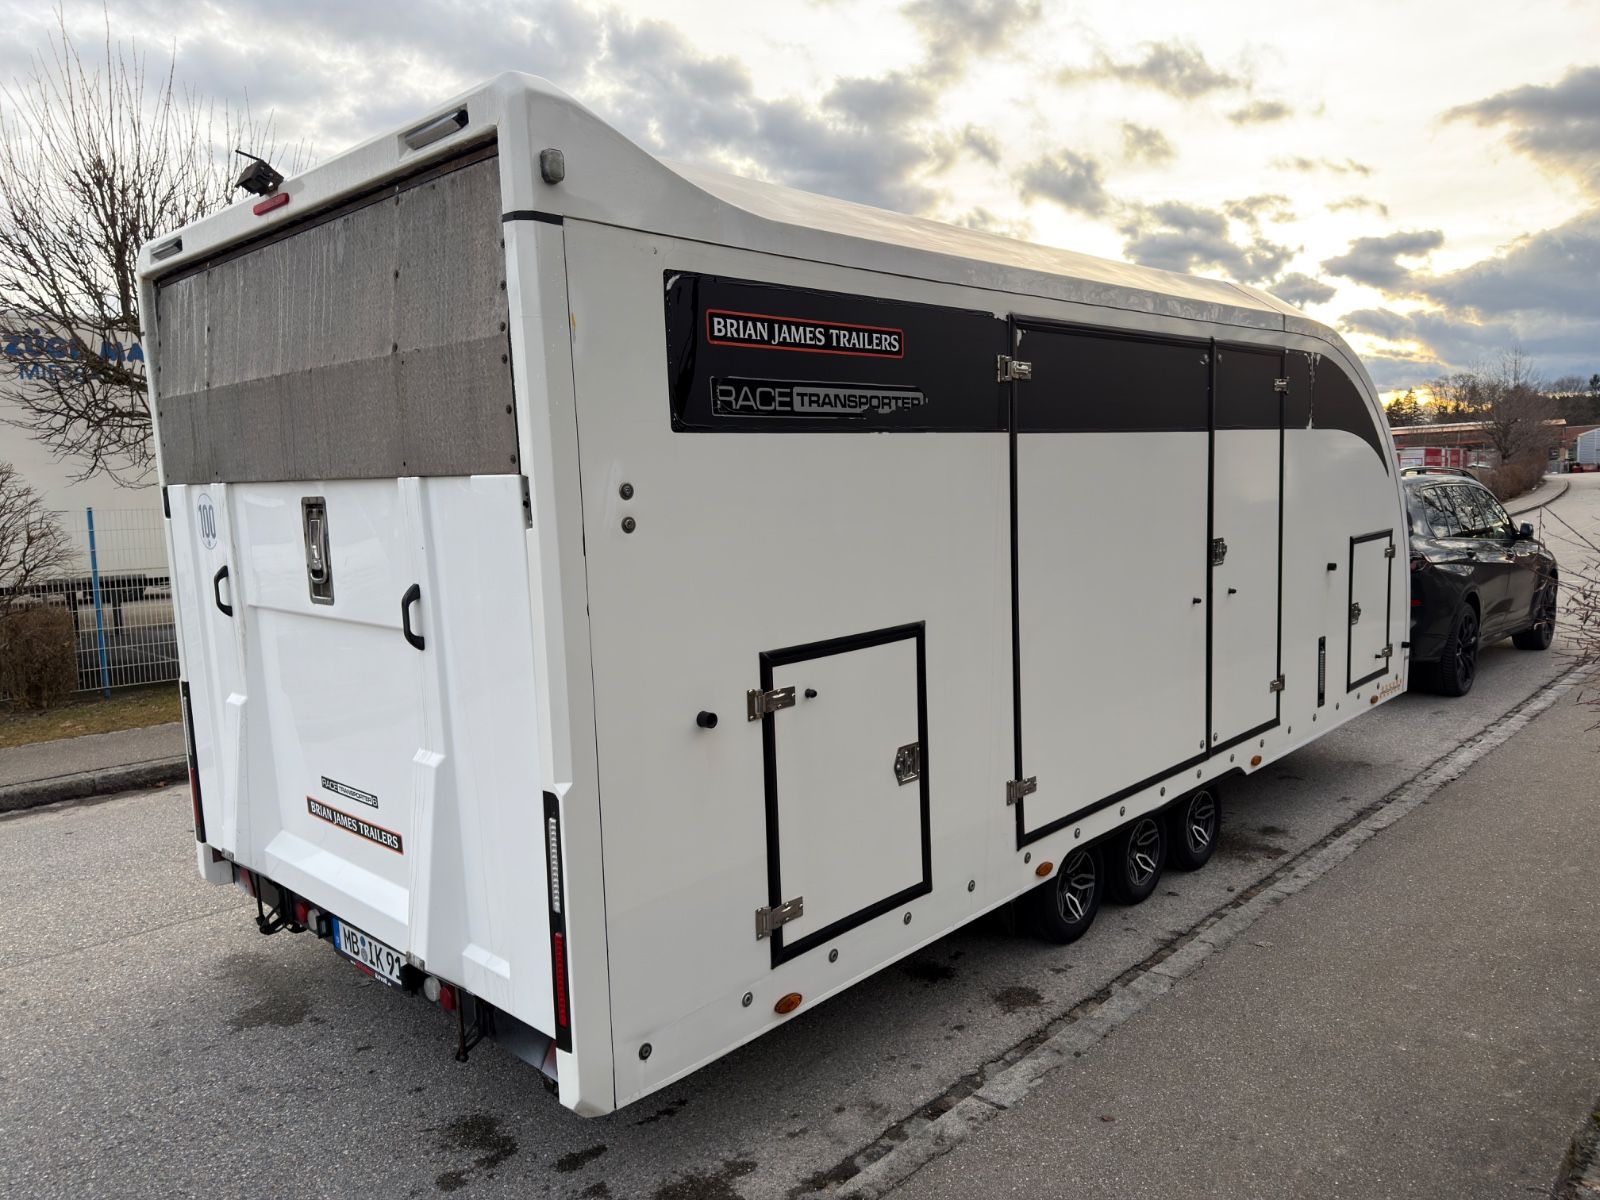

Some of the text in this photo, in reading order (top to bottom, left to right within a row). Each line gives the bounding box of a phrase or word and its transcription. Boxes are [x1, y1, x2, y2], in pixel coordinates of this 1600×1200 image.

[713, 316, 900, 352] BRIAN JAMES TRAILERS
[716, 385, 792, 411] RACE
[198, 504, 216, 539] 100
[321, 778, 338, 792] RACE
[338, 785, 372, 803] TRANSPORTER
[310, 801, 399, 849] BRIAN JAMES TRAILERS
[342, 927, 360, 956] MB
[368, 941, 385, 972] IK
